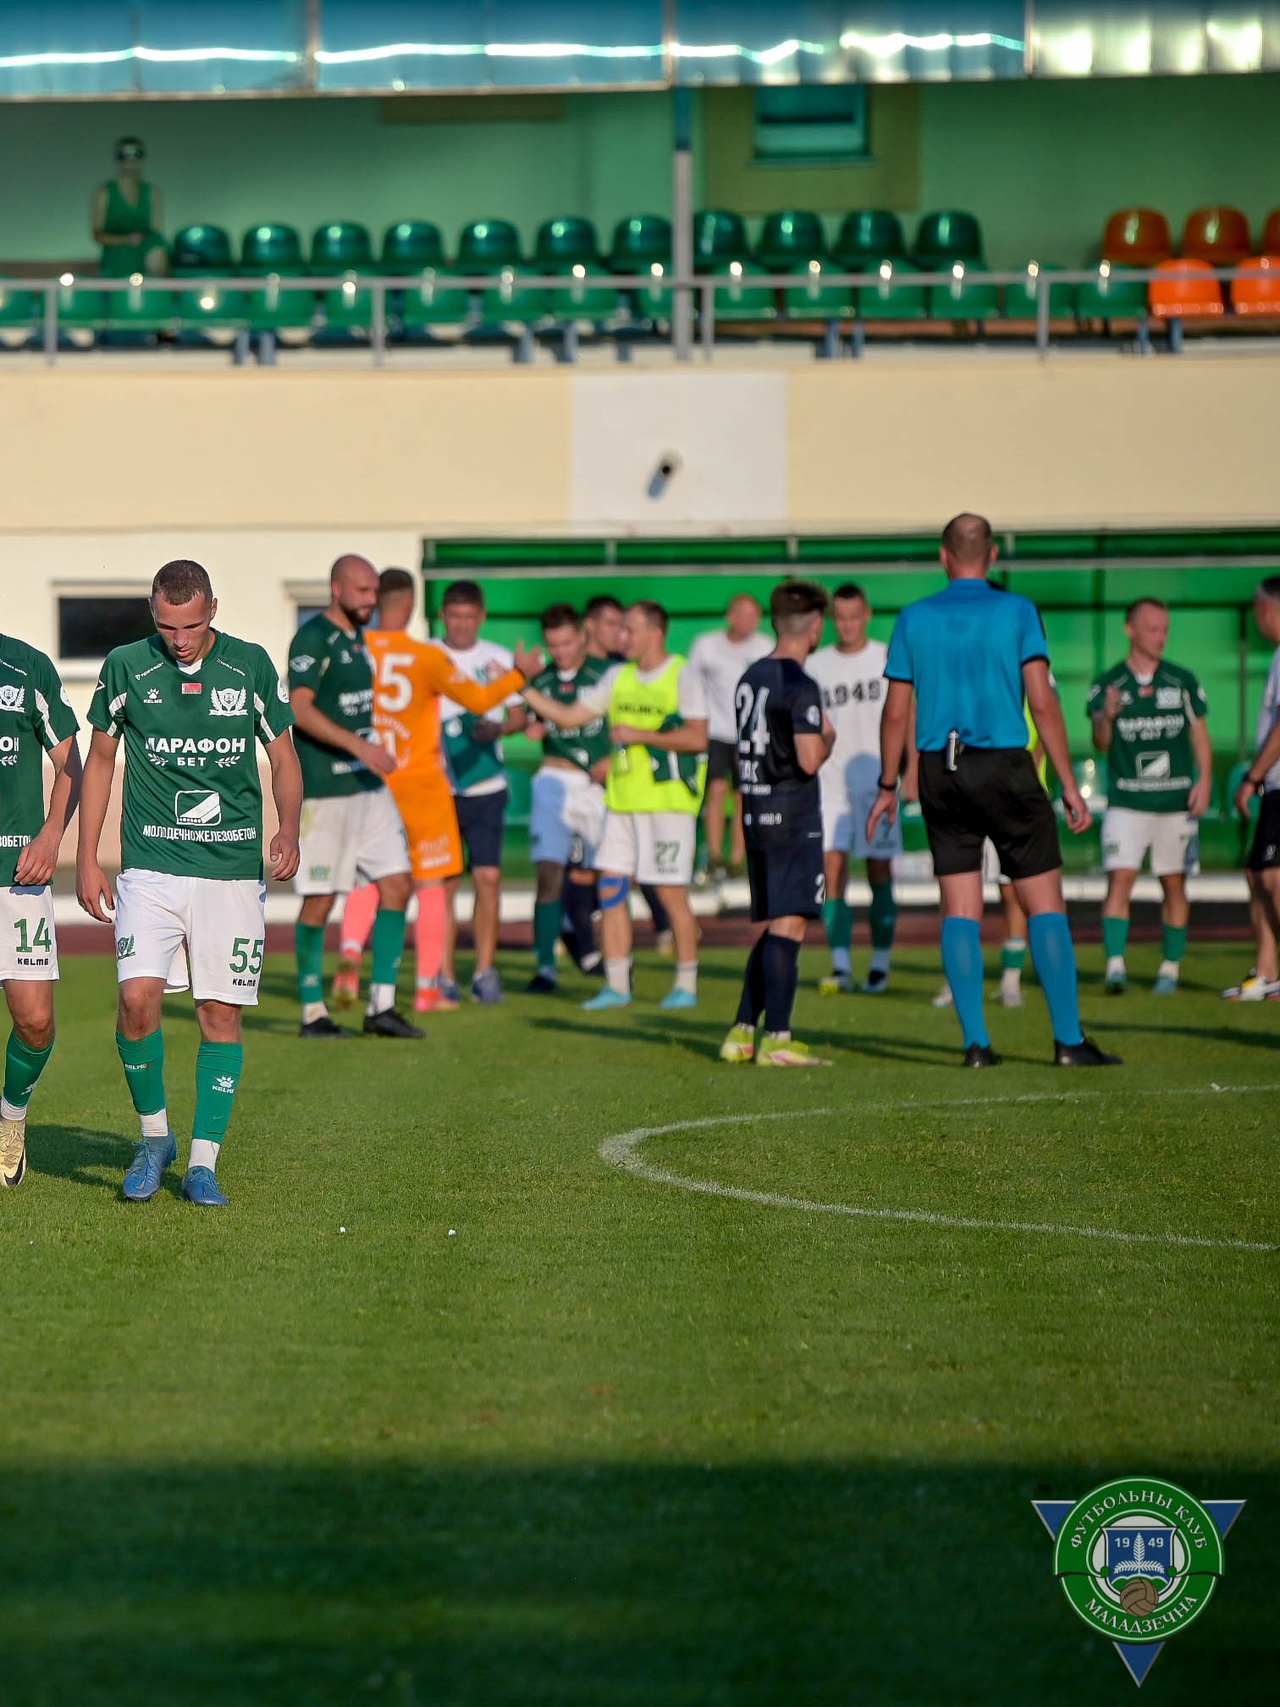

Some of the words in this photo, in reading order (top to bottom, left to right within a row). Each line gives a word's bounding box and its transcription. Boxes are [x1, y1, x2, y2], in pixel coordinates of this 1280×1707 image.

[735, 682, 770, 755] 24
[177, 757, 206, 766] БЕТ
[13, 917, 52, 953] 14
[17, 957, 48, 966] KELME
[229, 937, 263, 974] 55
[232, 978, 256, 987] KELME
